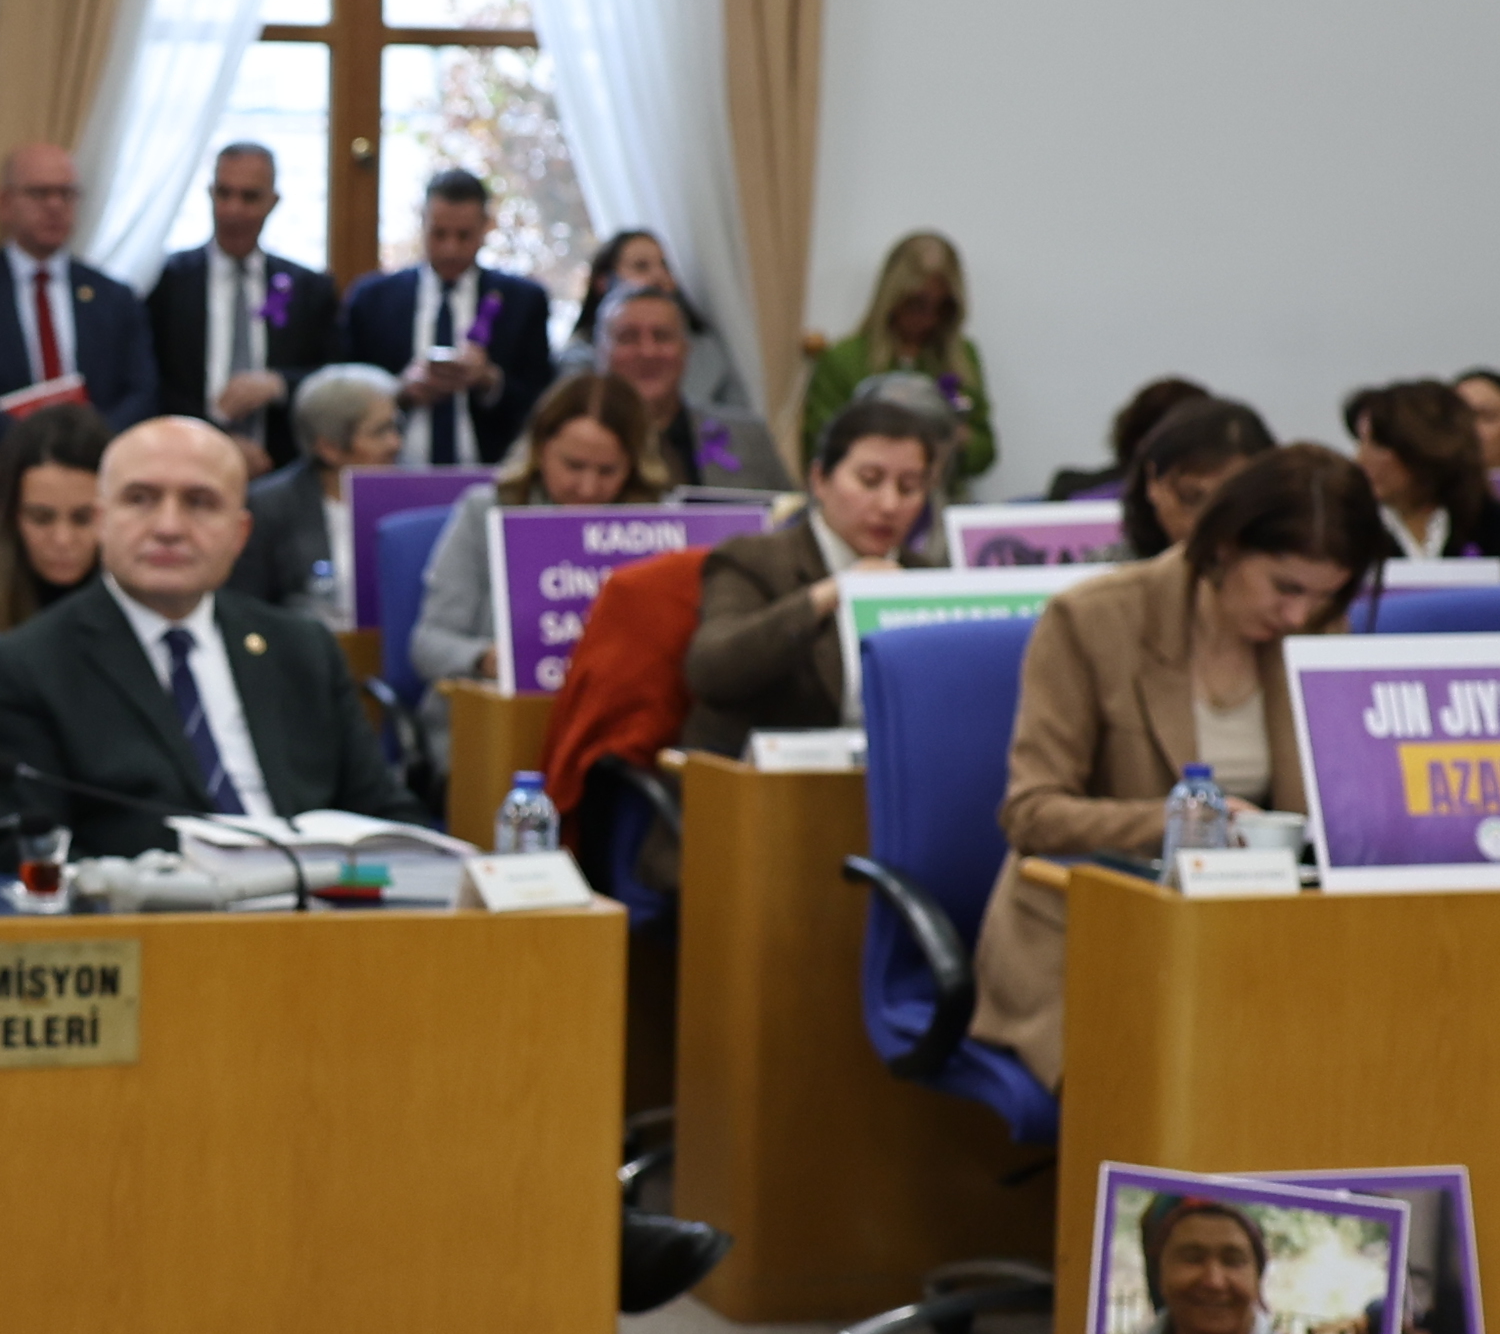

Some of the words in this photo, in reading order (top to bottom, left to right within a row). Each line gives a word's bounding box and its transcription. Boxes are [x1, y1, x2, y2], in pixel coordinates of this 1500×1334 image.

[582, 521, 687, 555] KADIN
[539, 610, 593, 645] SA
[1362, 679, 1433, 738] JIN
